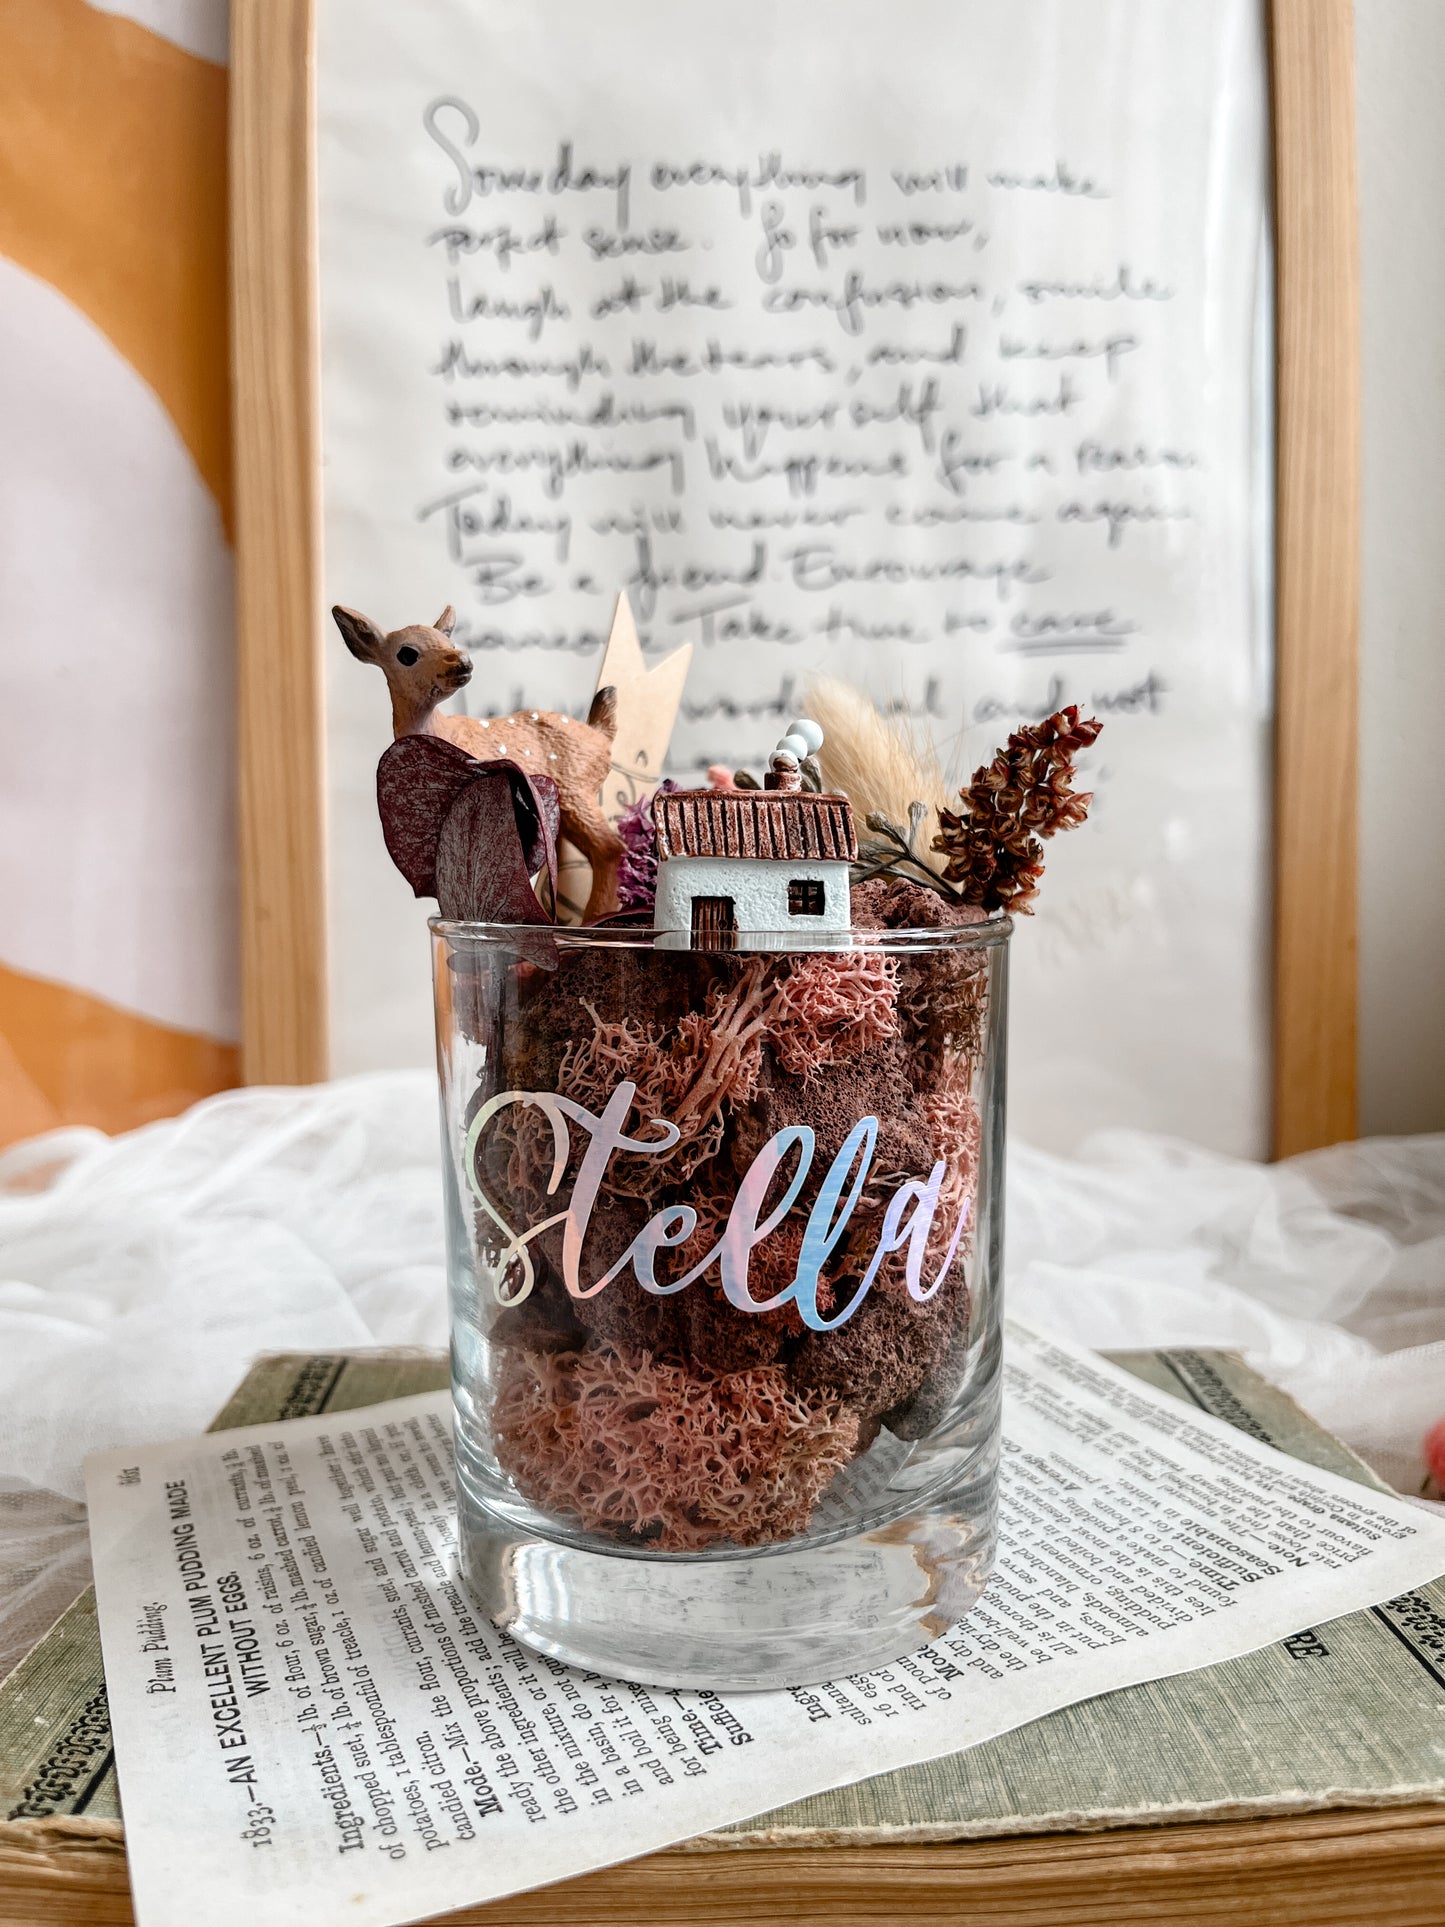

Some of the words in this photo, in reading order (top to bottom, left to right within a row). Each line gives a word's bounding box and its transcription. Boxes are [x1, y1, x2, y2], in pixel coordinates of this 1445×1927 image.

[423, 96, 631, 228] Someday
[651, 151, 866, 218] everything
[892, 165, 966, 195] will
[465, 1081, 970, 1331] Stella
[164, 1479, 191, 1520] MADE
[1014, 1485, 1071, 1523] desirable
[1116, 1477, 1161, 1508] winter.
[1058, 1496, 1120, 1533] pudding
[1091, 1497, 1133, 1526] hours.
[1148, 1519, 1174, 1532] for
[247, 1533, 262, 1549] oz.
[297, 1535, 327, 1573] candied
[1054, 1535, 1104, 1566] boiled
[1071, 1526, 1110, 1549] most
[1126, 1541, 1169, 1566] make
[1179, 1518, 1284, 1575] Seasonable
[170, 1522, 208, 1591] PUDDING
[274, 1548, 304, 1587] mashed
[363, 1557, 388, 1576] and
[390, 1548, 418, 1578] carrot
[422, 1559, 446, 1577] and
[999, 1557, 1037, 1584] serve
[1011, 1547, 1080, 1593] blanched
[1031, 1539, 1102, 1584] ornament
[1109, 1549, 1136, 1566] the
[1170, 1532, 1264, 1583] Sufficient
[254, 1563, 279, 1600] raisins,
[376, 1577, 400, 1602] suet,
[1098, 1565, 1134, 1584] and
[216, 1570, 248, 1613] EGGS.
[289, 1587, 309, 1603] lb.
[324, 1588, 339, 1604] oz.
[403, 1579, 440, 1619] mashed
[436, 1580, 467, 1615] treacle
[1035, 1587, 1071, 1608] and
[1104, 1585, 1177, 1630] pudding,
[1129, 1585, 1193, 1622] divided
[135, 1601, 169, 1652] Pudding.
[188, 1594, 221, 1637] PLUM
[275, 1618, 290, 1635] oz.
[458, 1616, 478, 1636] the
[1027, 1602, 1055, 1620] the
[1079, 1611, 1127, 1644] hours,
[1082, 1591, 1149, 1636] almonds,
[302, 1611, 325, 1646] sugar,
[331, 1617, 362, 1660] treacle,
[391, 1603, 424, 1653] currants,
[971, 1633, 1000, 1650] dry
[1069, 1631, 1108, 1649] put
[228, 1619, 271, 1698] WITHOUT
[464, 1637, 492, 1661] add
[501, 1646, 529, 1672] will
[532, 1652, 574, 1676] quit
[944, 1639, 972, 1657] dry
[999, 1651, 1028, 1671] the
[1047, 1641, 1078, 1655] all
[146, 1657, 176, 1694] Plum
[284, 1649, 306, 1681] flour,
[314, 1647, 340, 1686] brown
[415, 1655, 441, 1690] flour,
[437, 1635, 489, 1708] proportions
[966, 1657, 1003, 1679] and
[199, 1643, 247, 1749] EXCELLENT
[429, 1694, 453, 1717] the
[552, 1678, 581, 1701] not
[599, 1694, 623, 1713] for
[886, 1683, 927, 1710] rind
[296, 1703, 319, 1723] lb.
[330, 1700, 353, 1720] lb.
[353, 1677, 406, 1767] tablespoonful
[473, 1709, 506, 1750] above
[541, 1702, 583, 1759] mixture,
[586, 1721, 621, 1765] basin,
[618, 1728, 653, 1757] boil
[649, 1715, 688, 1755] being
[341, 1733, 371, 1767] suet,
[415, 1730, 445, 1775] citron.
[495, 1752, 520, 1777] the
[527, 1747, 560, 1784] other
[679, 1755, 707, 1776] for
[574, 1760, 599, 1786] the
[638, 1758, 674, 1785] and
[353, 1770, 397, 1836] chopped
[402, 1779, 450, 1851] potatoes,
[429, 1779, 476, 1841] candied
[508, 1781, 547, 1823] ready
[552, 1787, 578, 1814] the
